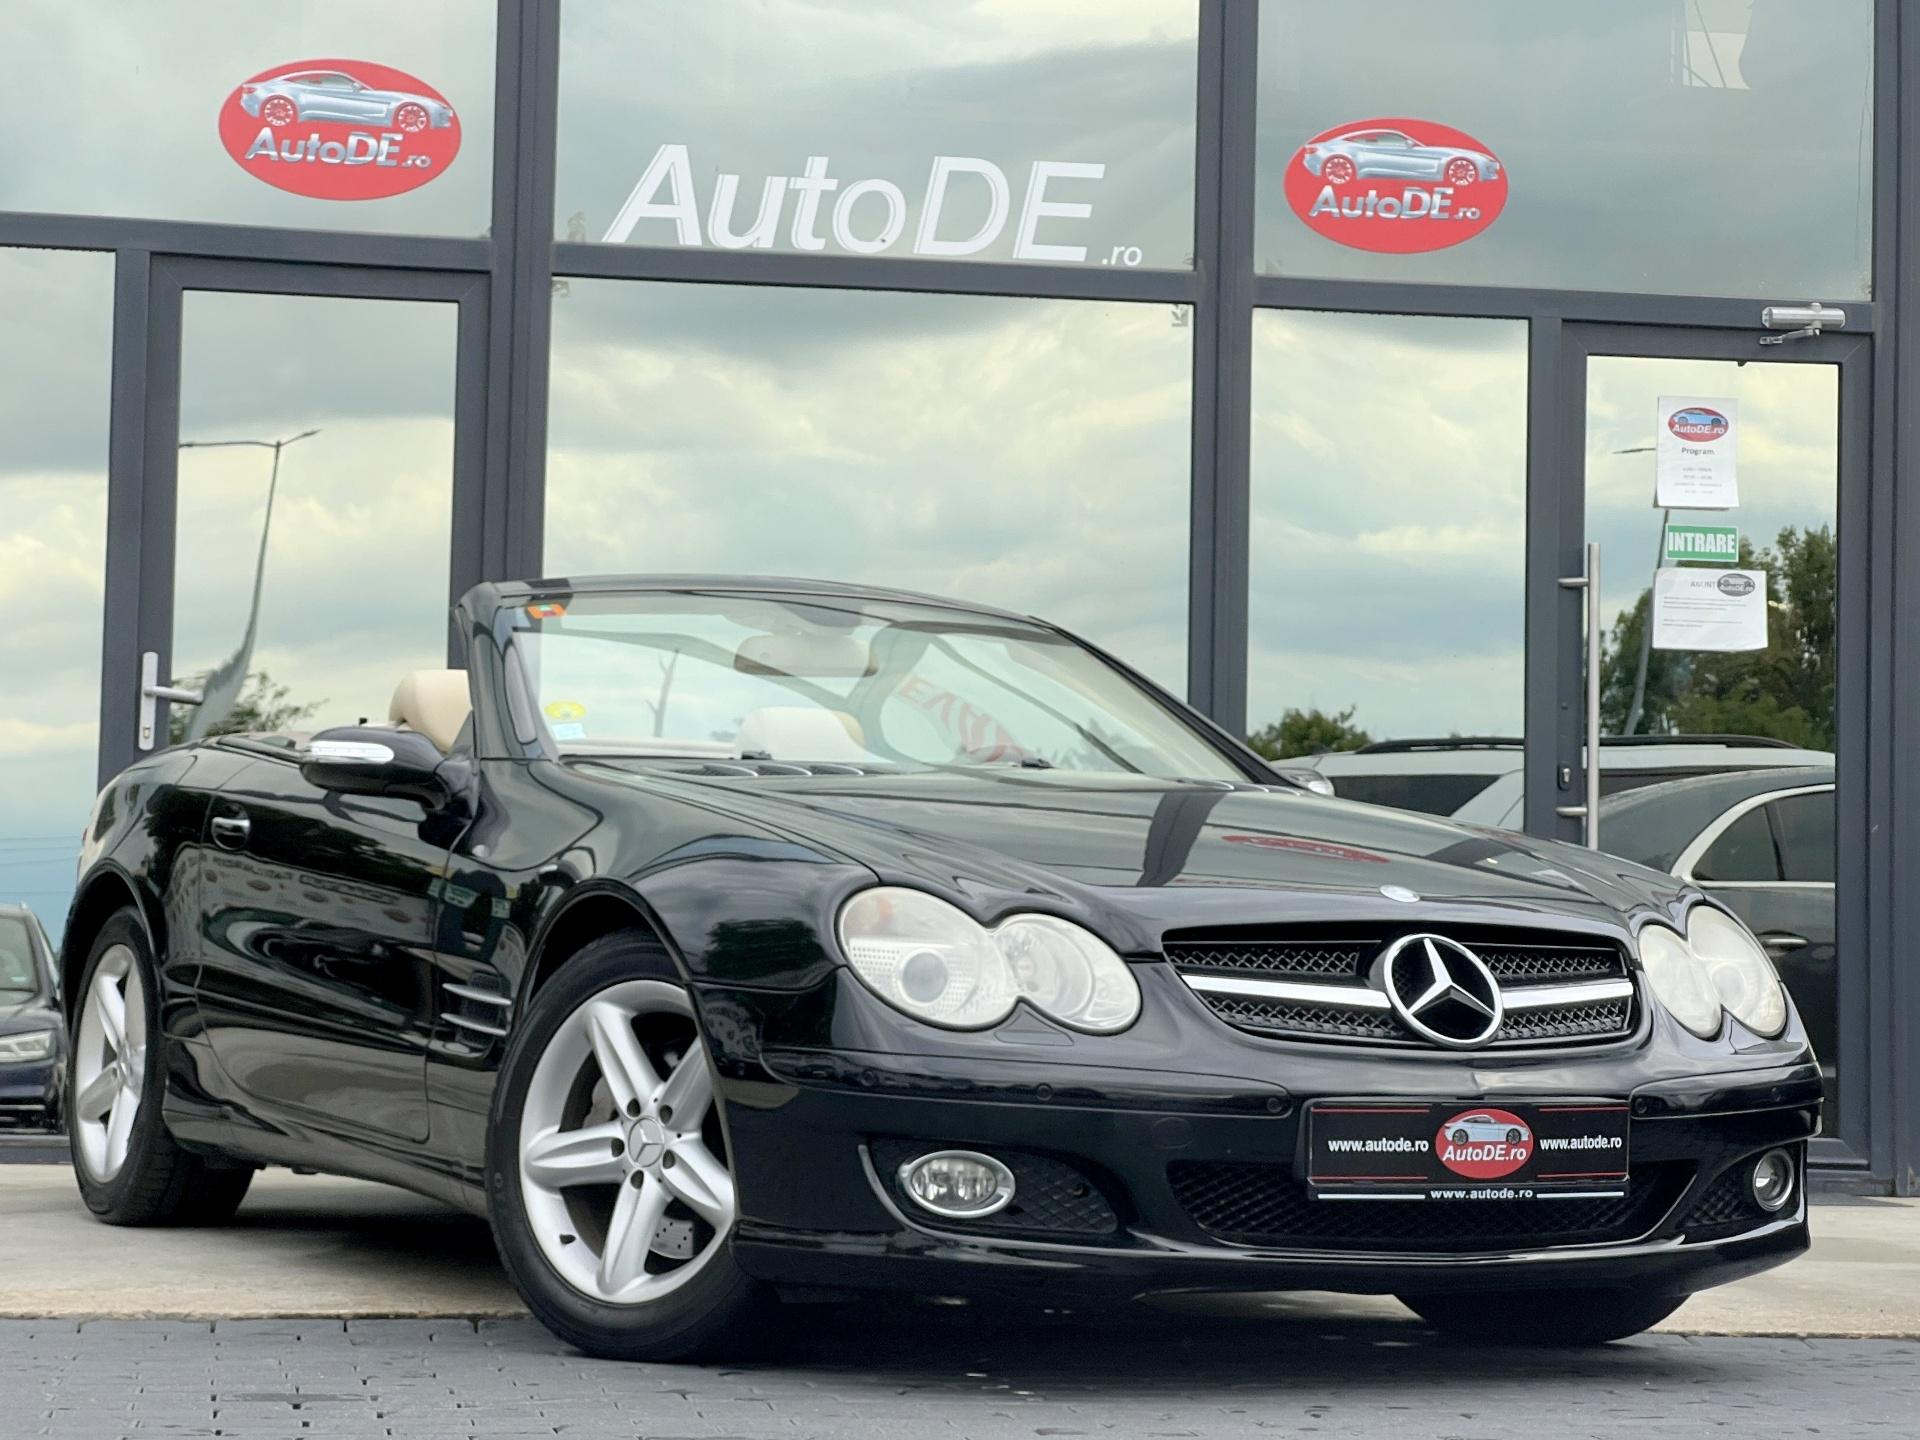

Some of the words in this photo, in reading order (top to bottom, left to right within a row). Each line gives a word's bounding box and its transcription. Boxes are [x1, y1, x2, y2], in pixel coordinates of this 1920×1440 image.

[1673, 424, 1725, 434] AutoDE.ro
[1681, 447, 1715, 456] Program
[1668, 531, 1736, 554] INTRARE
[1328, 1137, 1430, 1152] www.autode.ro
[1539, 1135, 1622, 1150] www.autode.ro
[1442, 1144, 1527, 1161] AutoDE.ro
[1430, 1188, 1533, 1199] www.autode.ro
